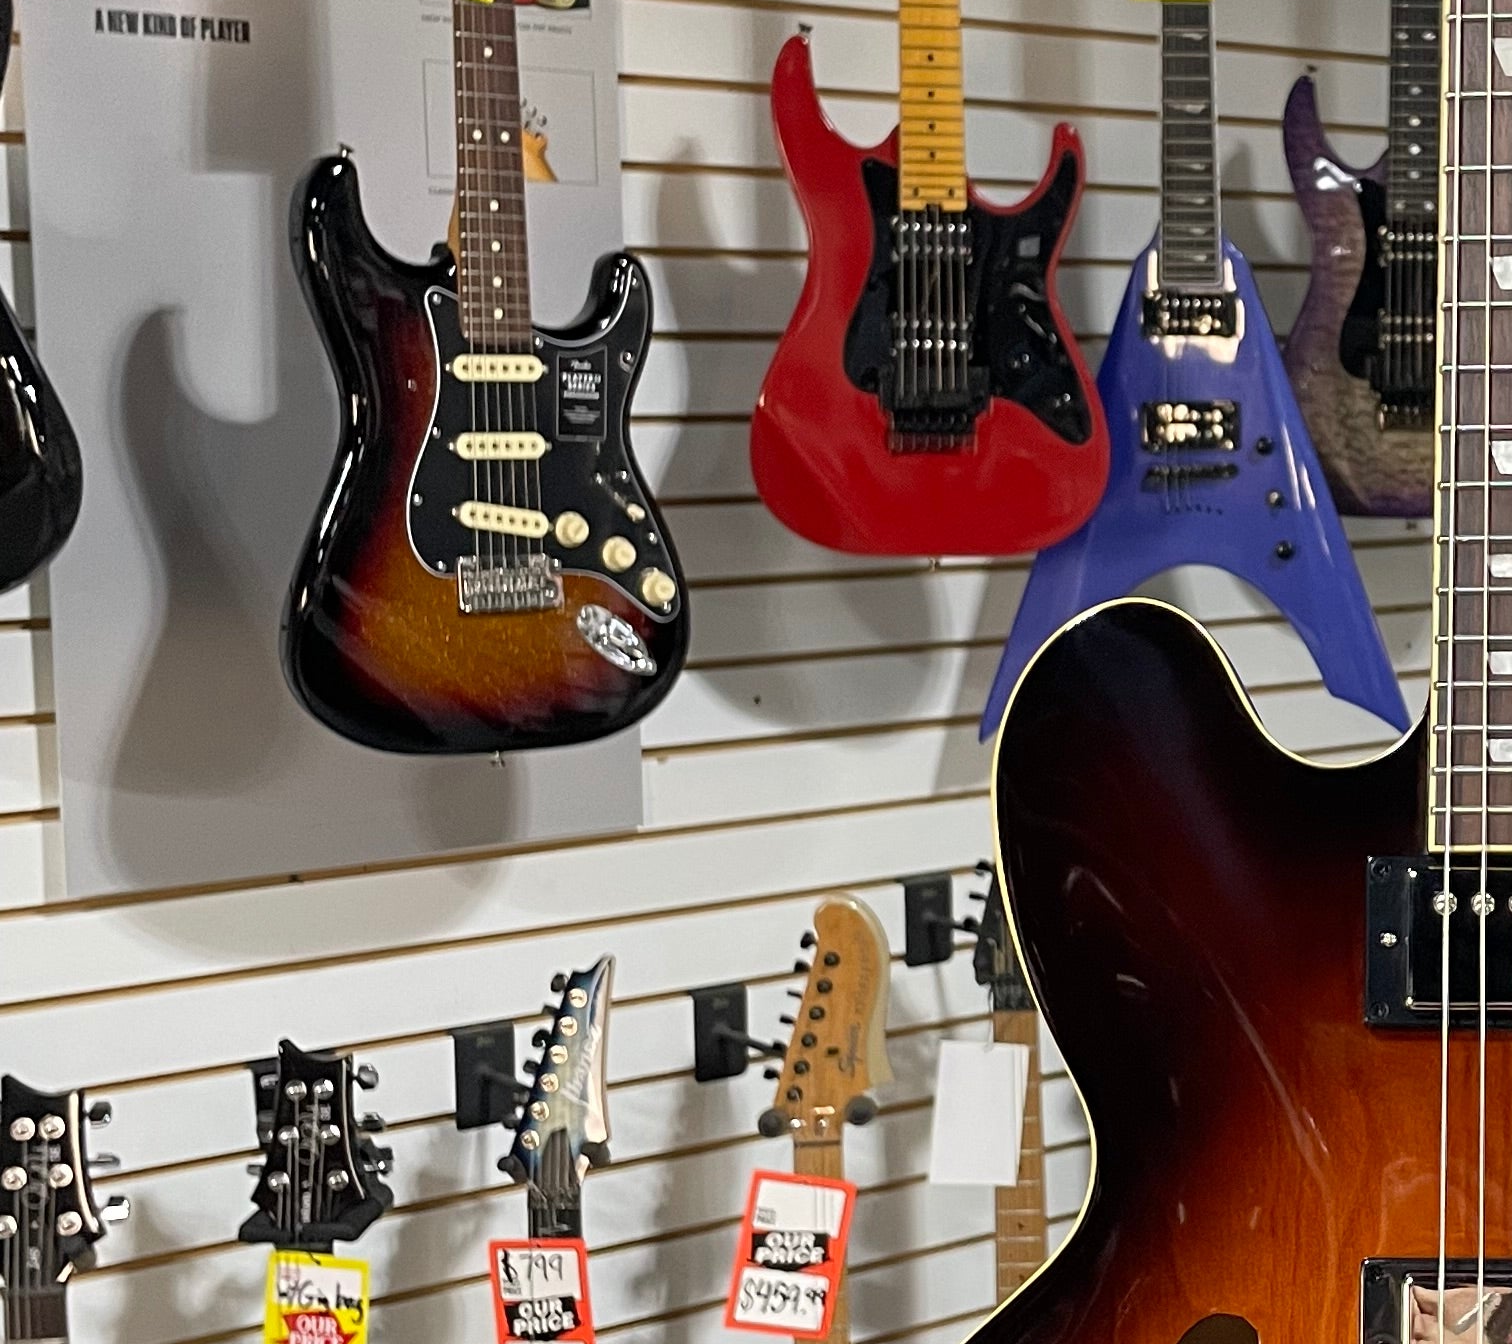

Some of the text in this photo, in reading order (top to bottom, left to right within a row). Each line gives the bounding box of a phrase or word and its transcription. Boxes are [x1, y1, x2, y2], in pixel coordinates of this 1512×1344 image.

[95, 9, 251, 44] A NEW KIND OF PLAYER
[765, 1231, 815, 1249] OUR
[754, 1246, 825, 1265] PRICE
[518, 1297, 563, 1320] OUR
[296, 1314, 337, 1335] OUR
[512, 1310, 576, 1337] PRICE
